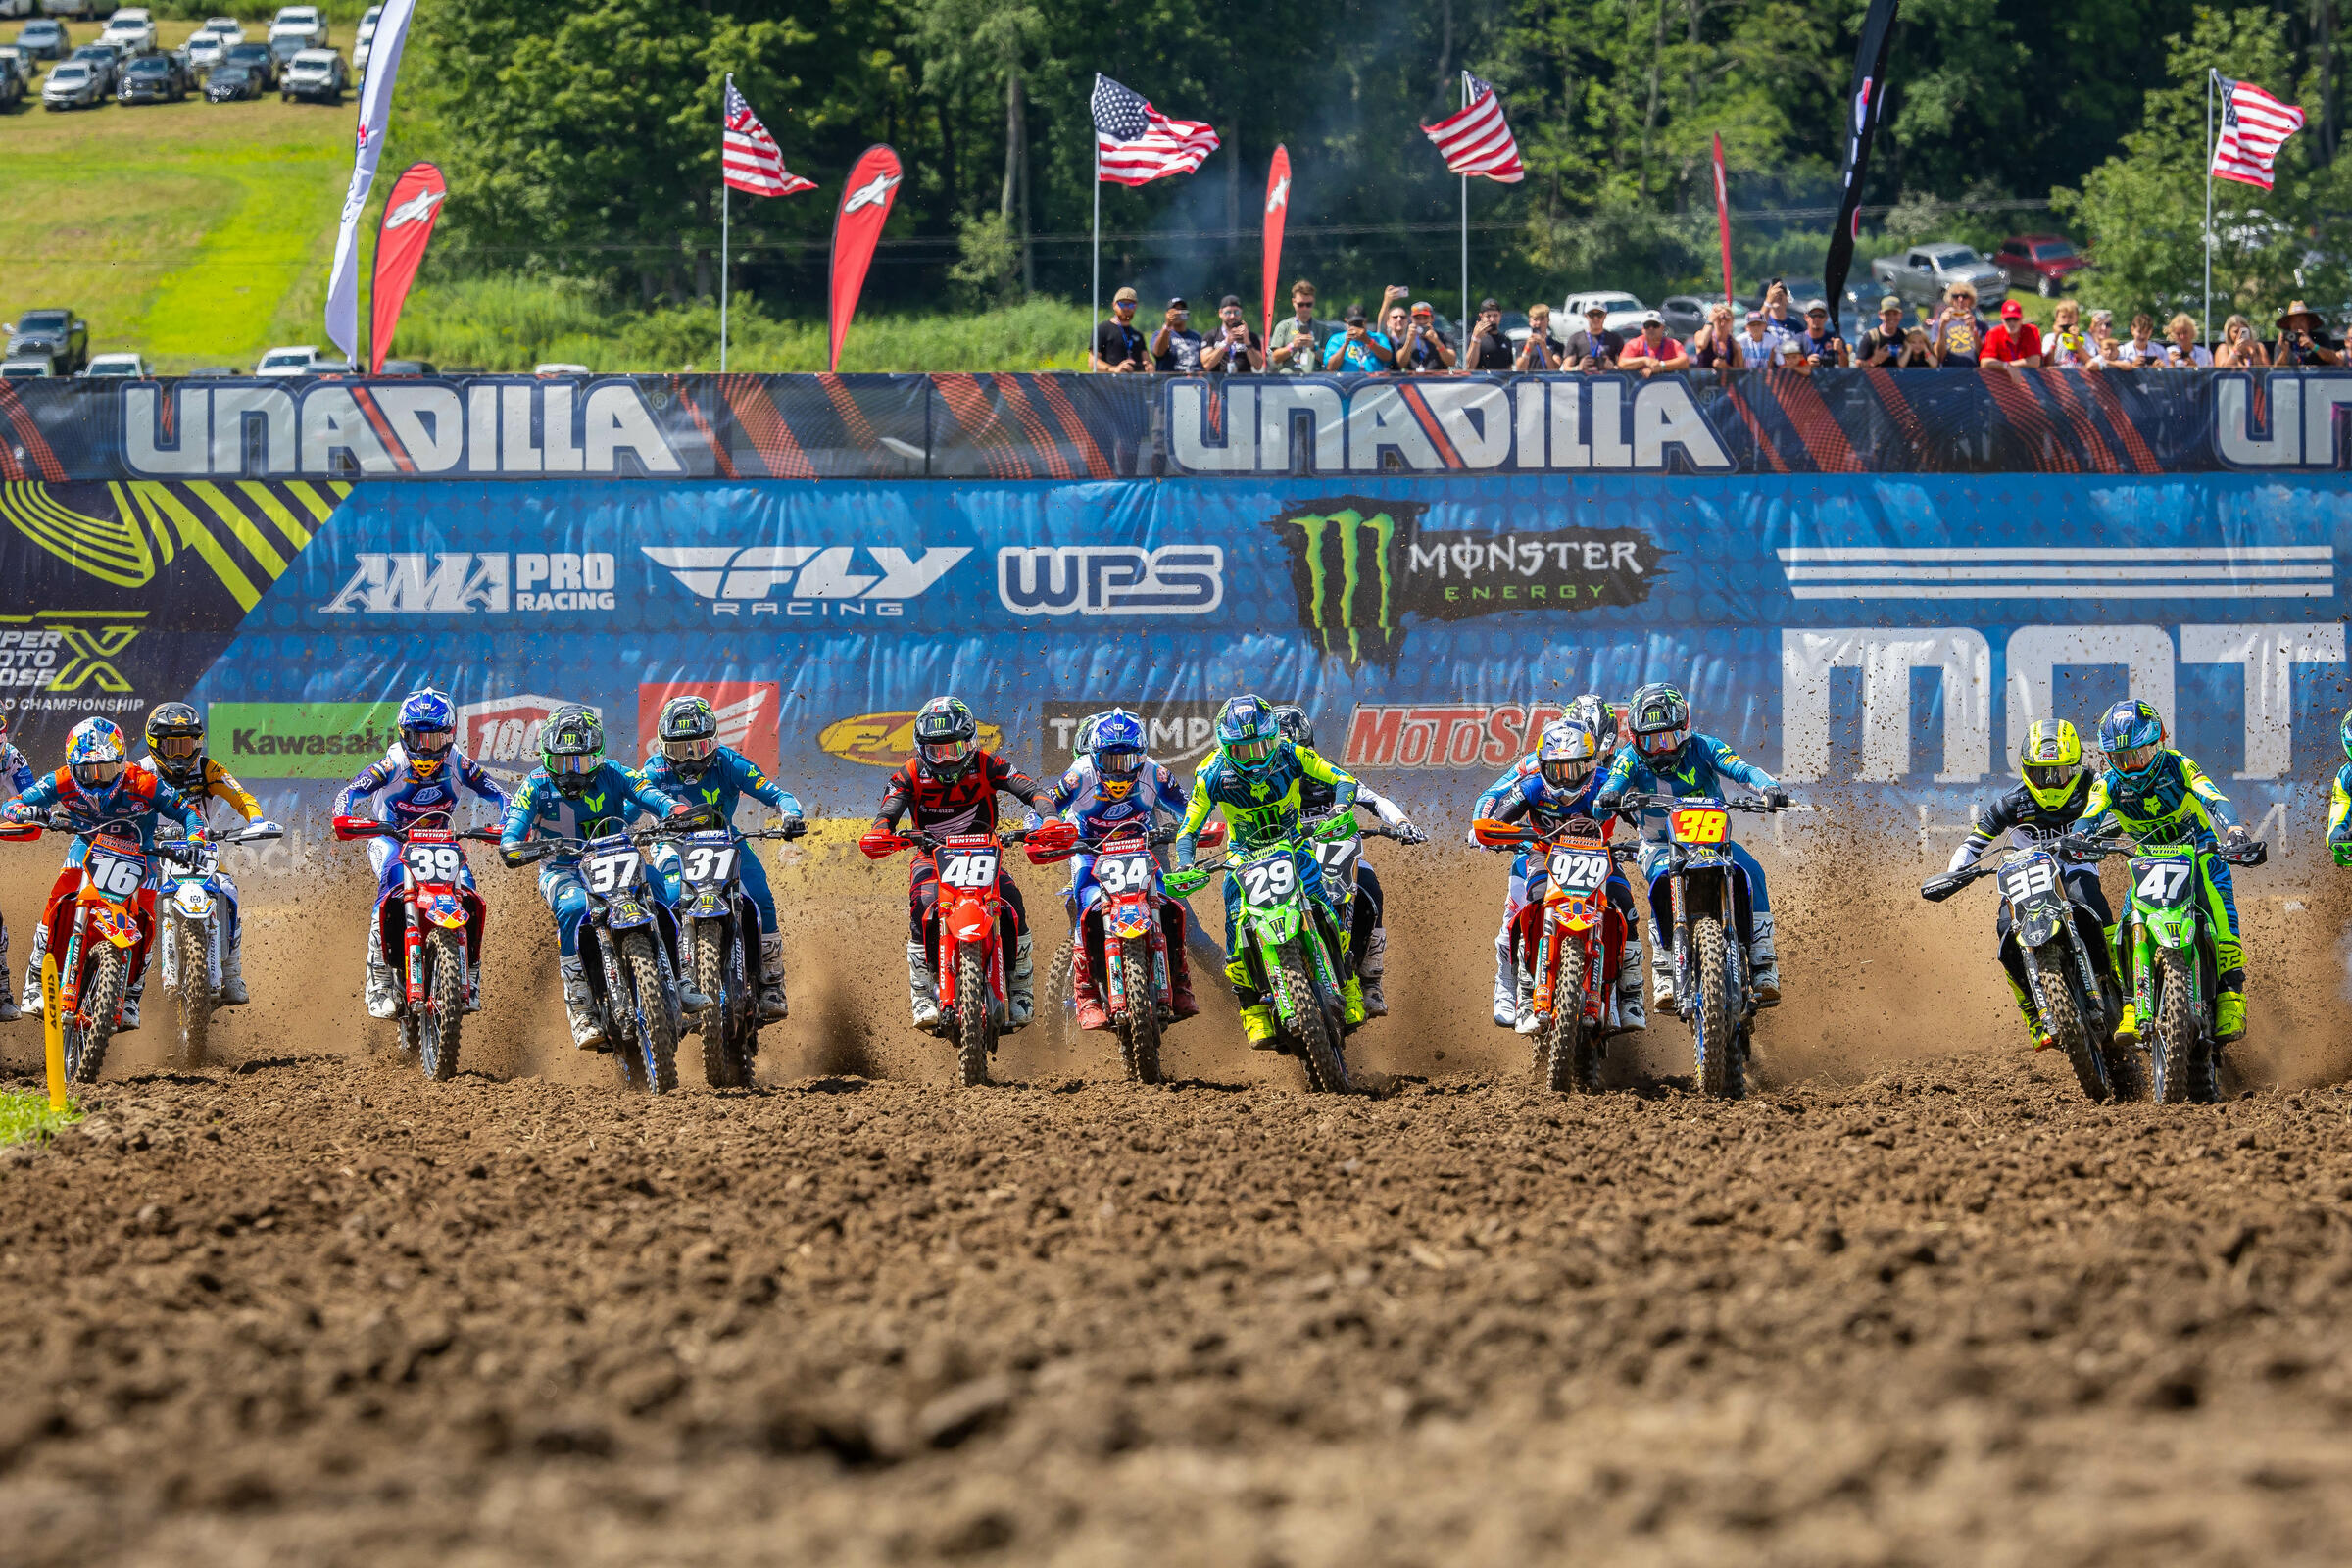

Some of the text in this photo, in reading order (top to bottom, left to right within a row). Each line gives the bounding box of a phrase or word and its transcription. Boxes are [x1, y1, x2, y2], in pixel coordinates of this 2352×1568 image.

[122, 382, 685, 477] UNADILLA
[1170, 378, 1735, 475] UNADILLA
[640, 547, 974, 599] FLY
[1409, 535, 1643, 579] MONSTER
[318, 552, 615, 613] AMA PRO
[997, 545, 1224, 616] WPS
[1445, 584, 1604, 600] ENERGY
[516, 592, 615, 612] RACING
[713, 602, 904, 616] RACING
[0, 630, 63, 648] PER
[20, 697, 145, 711] CHAMPIONSHIP
[232, 728, 395, 755] Kawasaki
[397, 800, 453, 813] GASGAS
[1675, 810, 1728, 843] 38
[91, 857, 143, 895] 16
[410, 848, 459, 882] 39
[590, 852, 640, 894] 37
[685, 848, 736, 883] 31
[941, 855, 997, 887] 48
[1100, 857, 1149, 894] 34
[1245, 860, 1295, 906] 29
[1551, 855, 1608, 888] 929
[2136, 863, 2190, 900] 47
[2007, 864, 2053, 906] 33
[119, 951, 128, 990] DUNLP
[603, 955, 618, 1001] DUNLOP
[735, 937, 744, 981] DUNLOP
[47, 974, 57, 1030] ACERBIS
[1273, 965, 1292, 1010] DUNLOP
[2142, 964, 2153, 1014] DUNLOP
